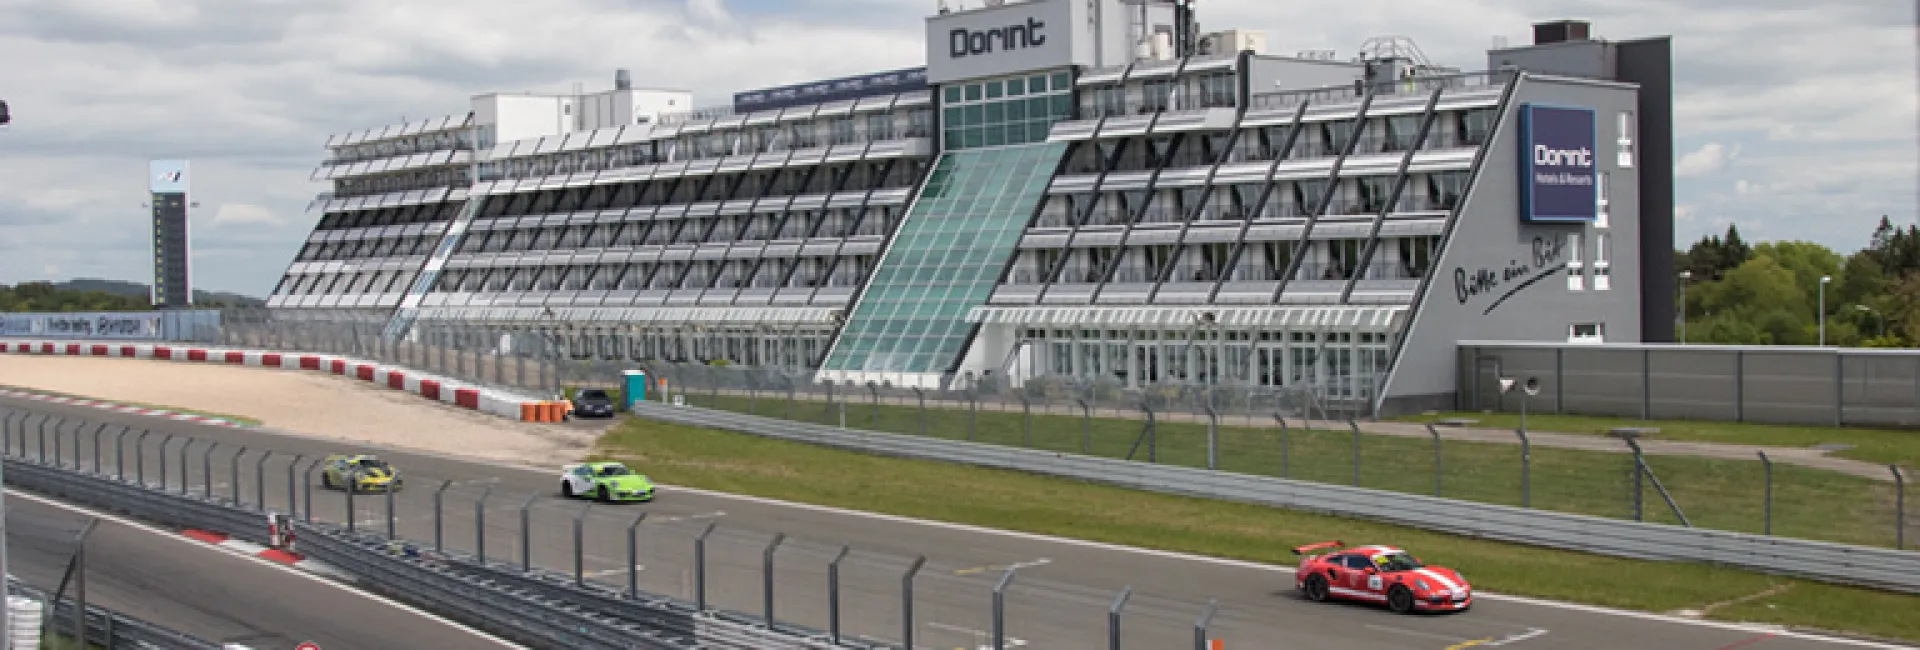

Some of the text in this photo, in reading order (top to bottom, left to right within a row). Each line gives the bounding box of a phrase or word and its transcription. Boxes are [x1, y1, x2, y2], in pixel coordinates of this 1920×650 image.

[950, 16, 1045, 58] Dorint
[1534, 144, 1592, 167] Dorint
[1455, 267, 1498, 305] Bitte
[1504, 260, 1530, 282] ein
